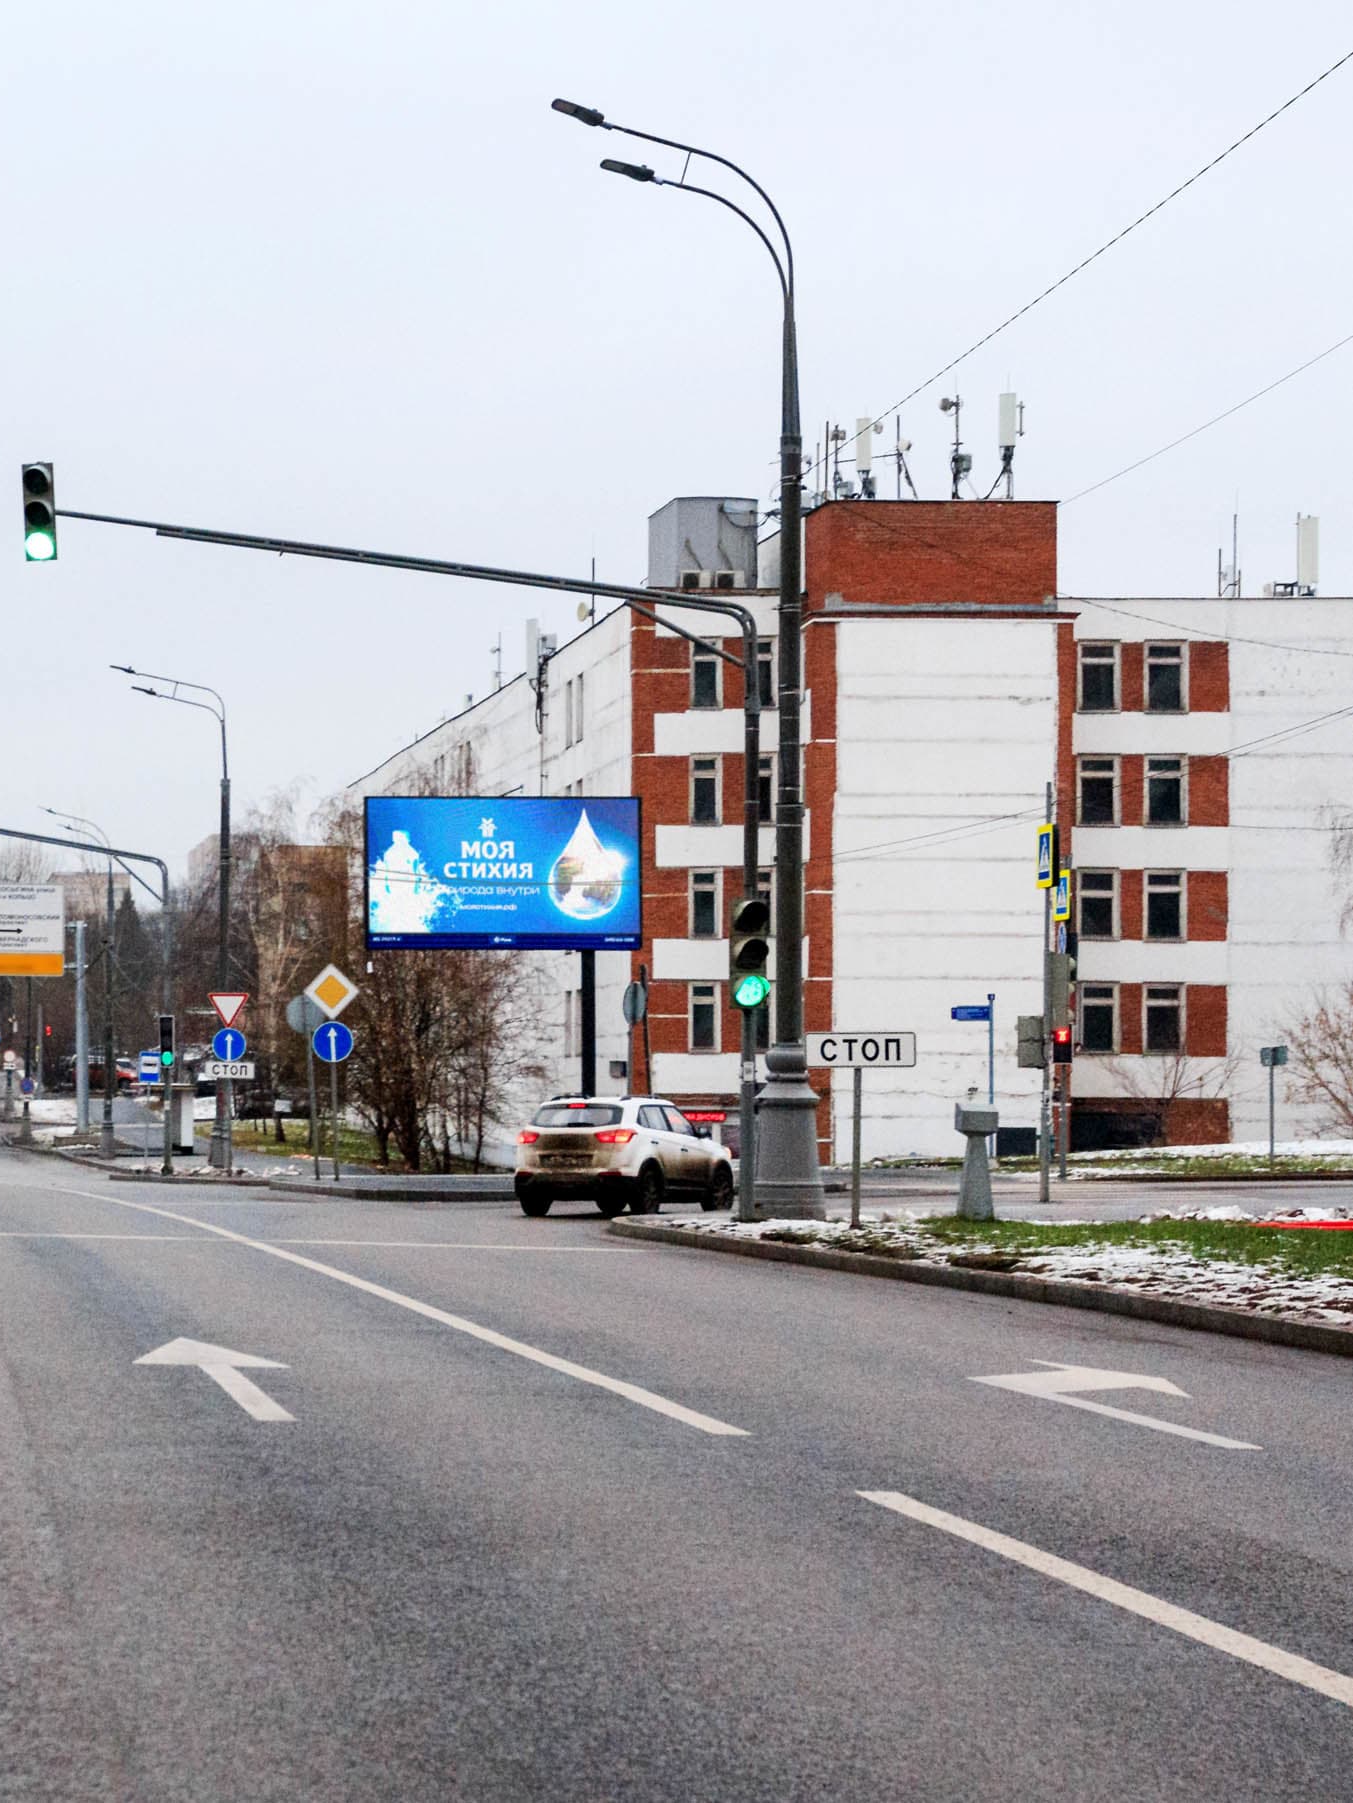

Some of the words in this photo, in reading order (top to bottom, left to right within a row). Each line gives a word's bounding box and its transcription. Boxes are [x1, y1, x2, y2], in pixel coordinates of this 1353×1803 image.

[460, 840, 515, 859] МОЯ
[443, 861, 534, 879] СТИХИЯ
[440, 885, 494, 897] рирода
[495, 885, 541, 897] внутри
[819, 1038, 902, 1062] СТОП
[212, 1064, 248, 1076] СТОП
